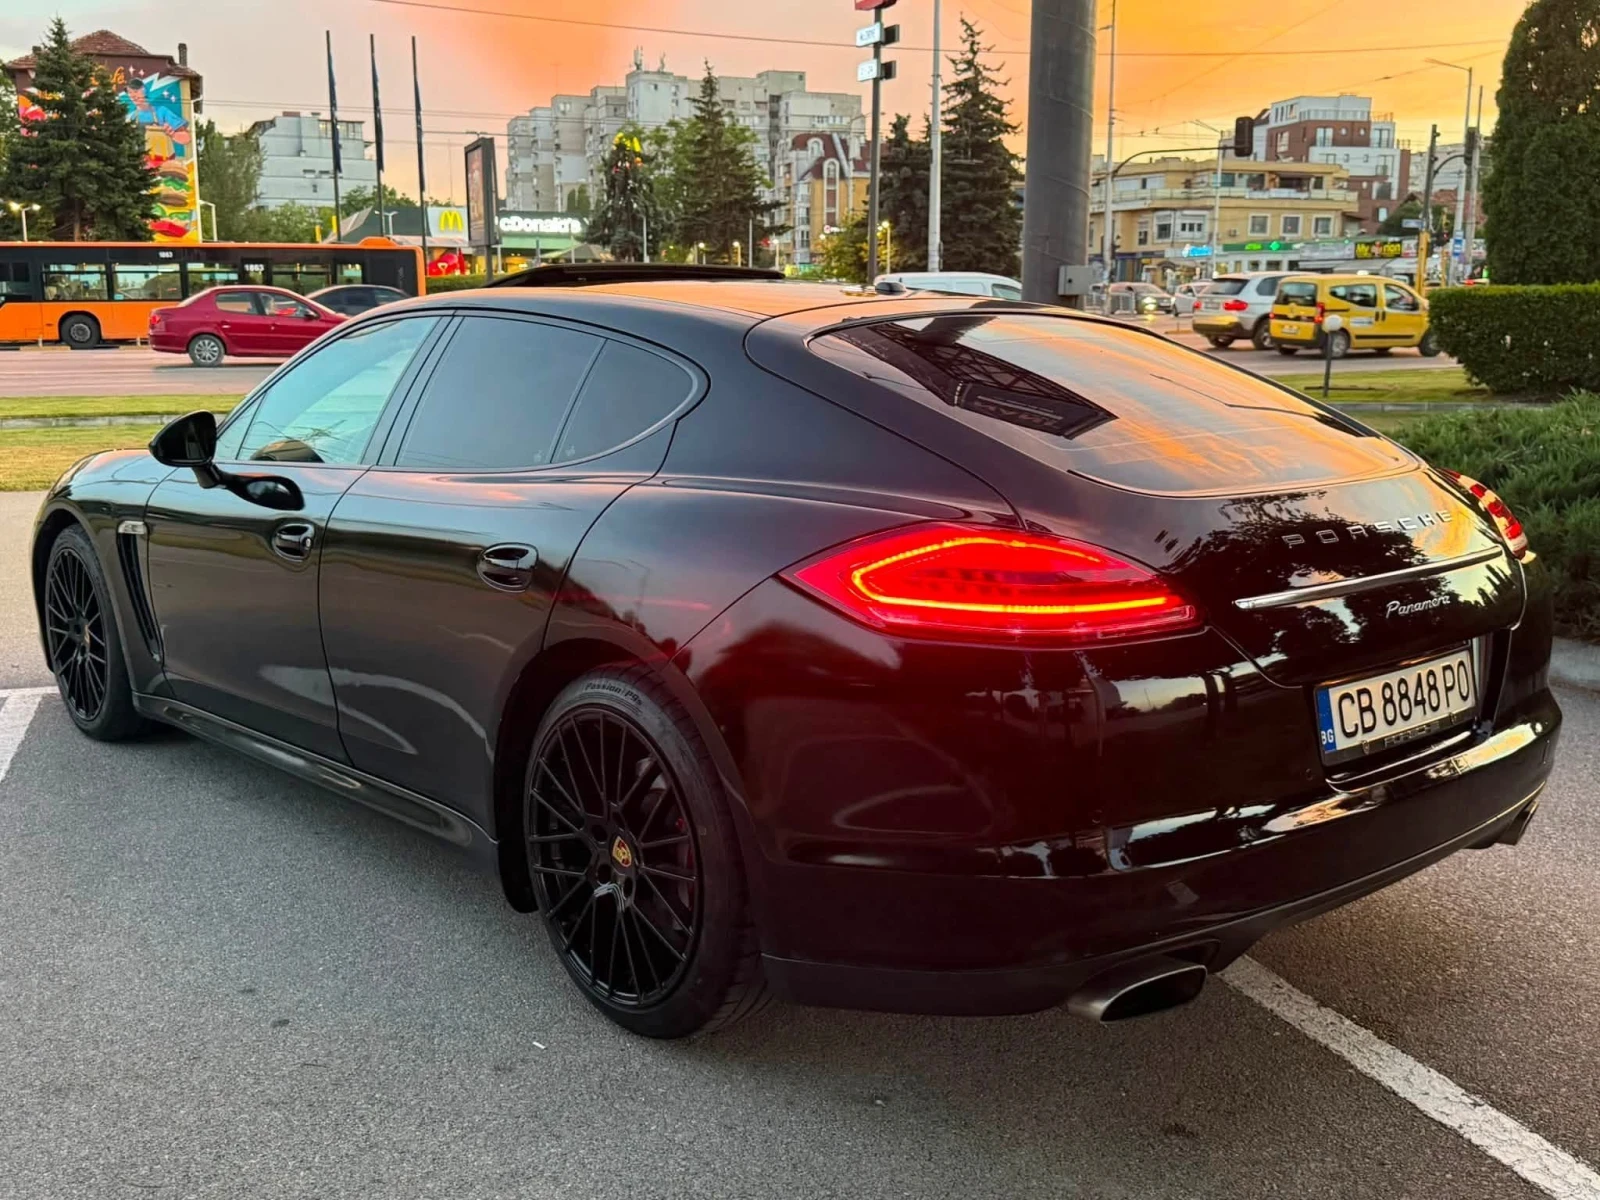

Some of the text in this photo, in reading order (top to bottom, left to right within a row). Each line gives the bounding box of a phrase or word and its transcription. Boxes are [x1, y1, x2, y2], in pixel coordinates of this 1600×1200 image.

[1281, 510, 1453, 549] PORSCHE
[1385, 595, 1452, 619] Panamera
[584, 682, 622, 694] Passion
[1337, 660, 1470, 739] CB 8848 PO
[1320, 728, 1335, 745] BG
